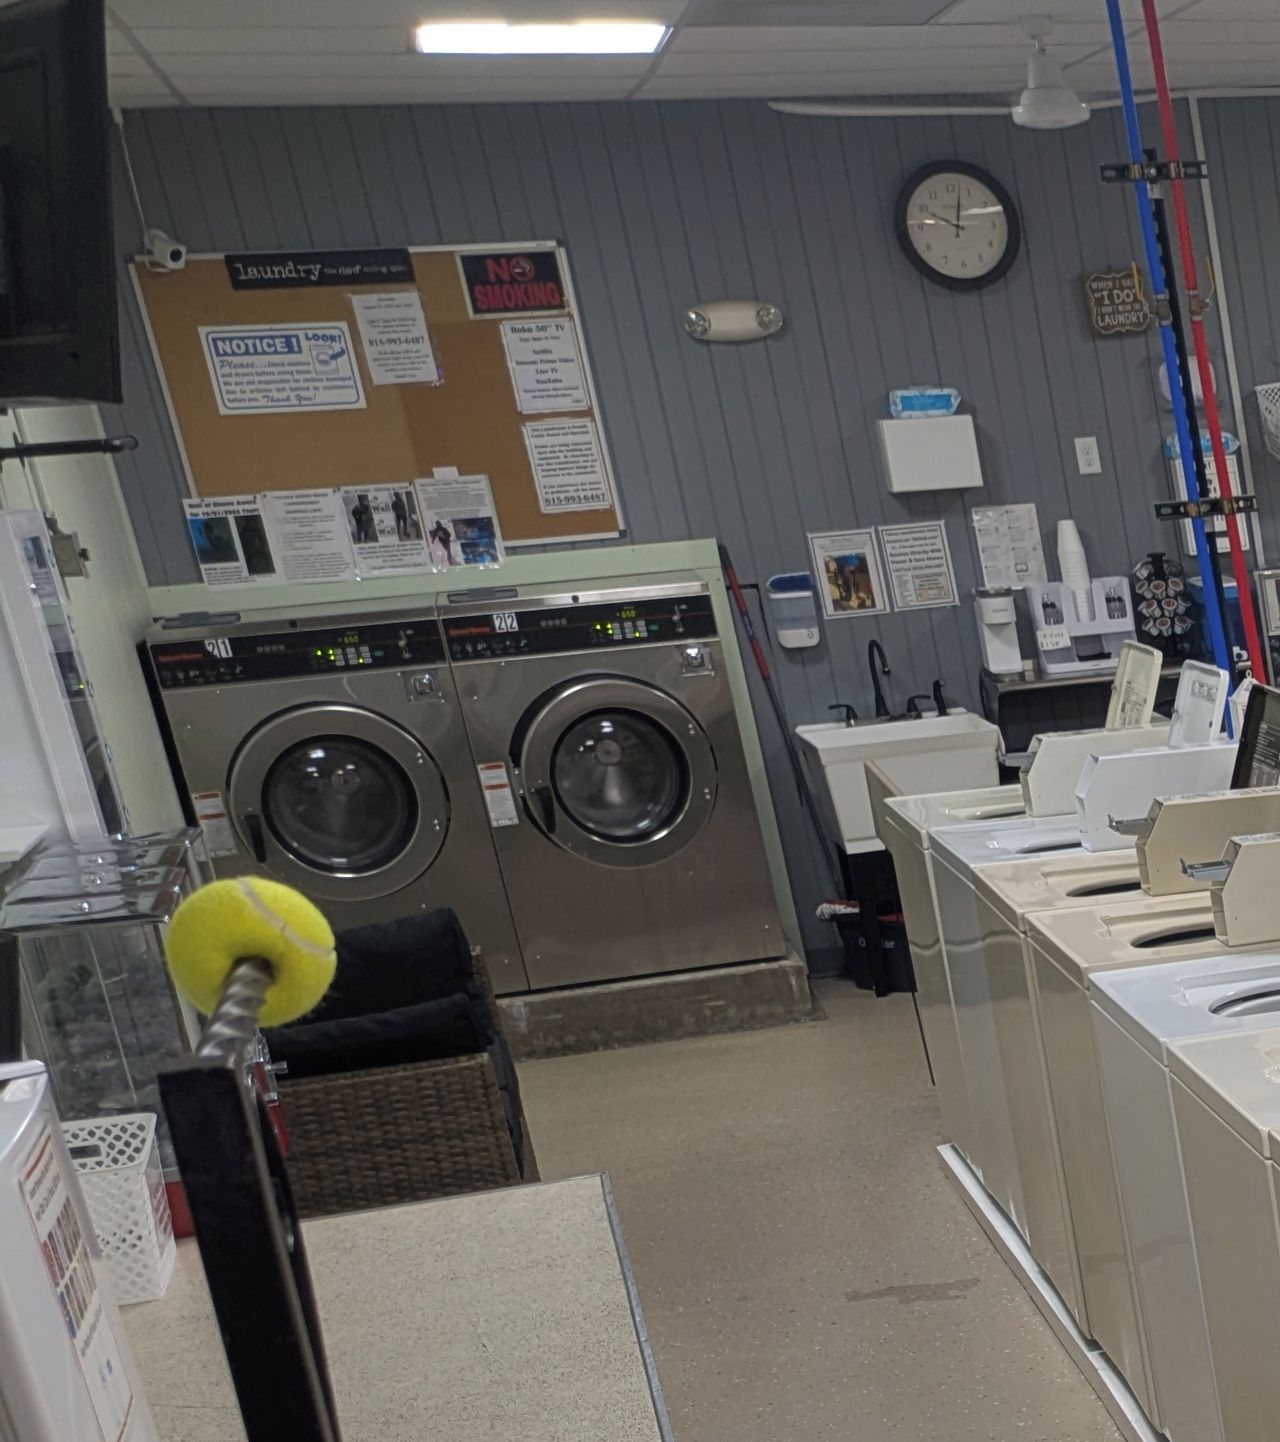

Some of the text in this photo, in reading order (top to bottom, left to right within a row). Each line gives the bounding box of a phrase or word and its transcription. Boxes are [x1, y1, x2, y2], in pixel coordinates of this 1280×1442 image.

[235, 262, 322, 281] laundry
[474, 282, 561, 309] SMOKING
[1098, 312, 1144, 327] LAUNDRY
[217, 338, 287, 354] NOTICE
[304, 332, 342, 344] LOOK!
[494, 614, 518, 632] 22
[206, 639, 232, 659] 21
